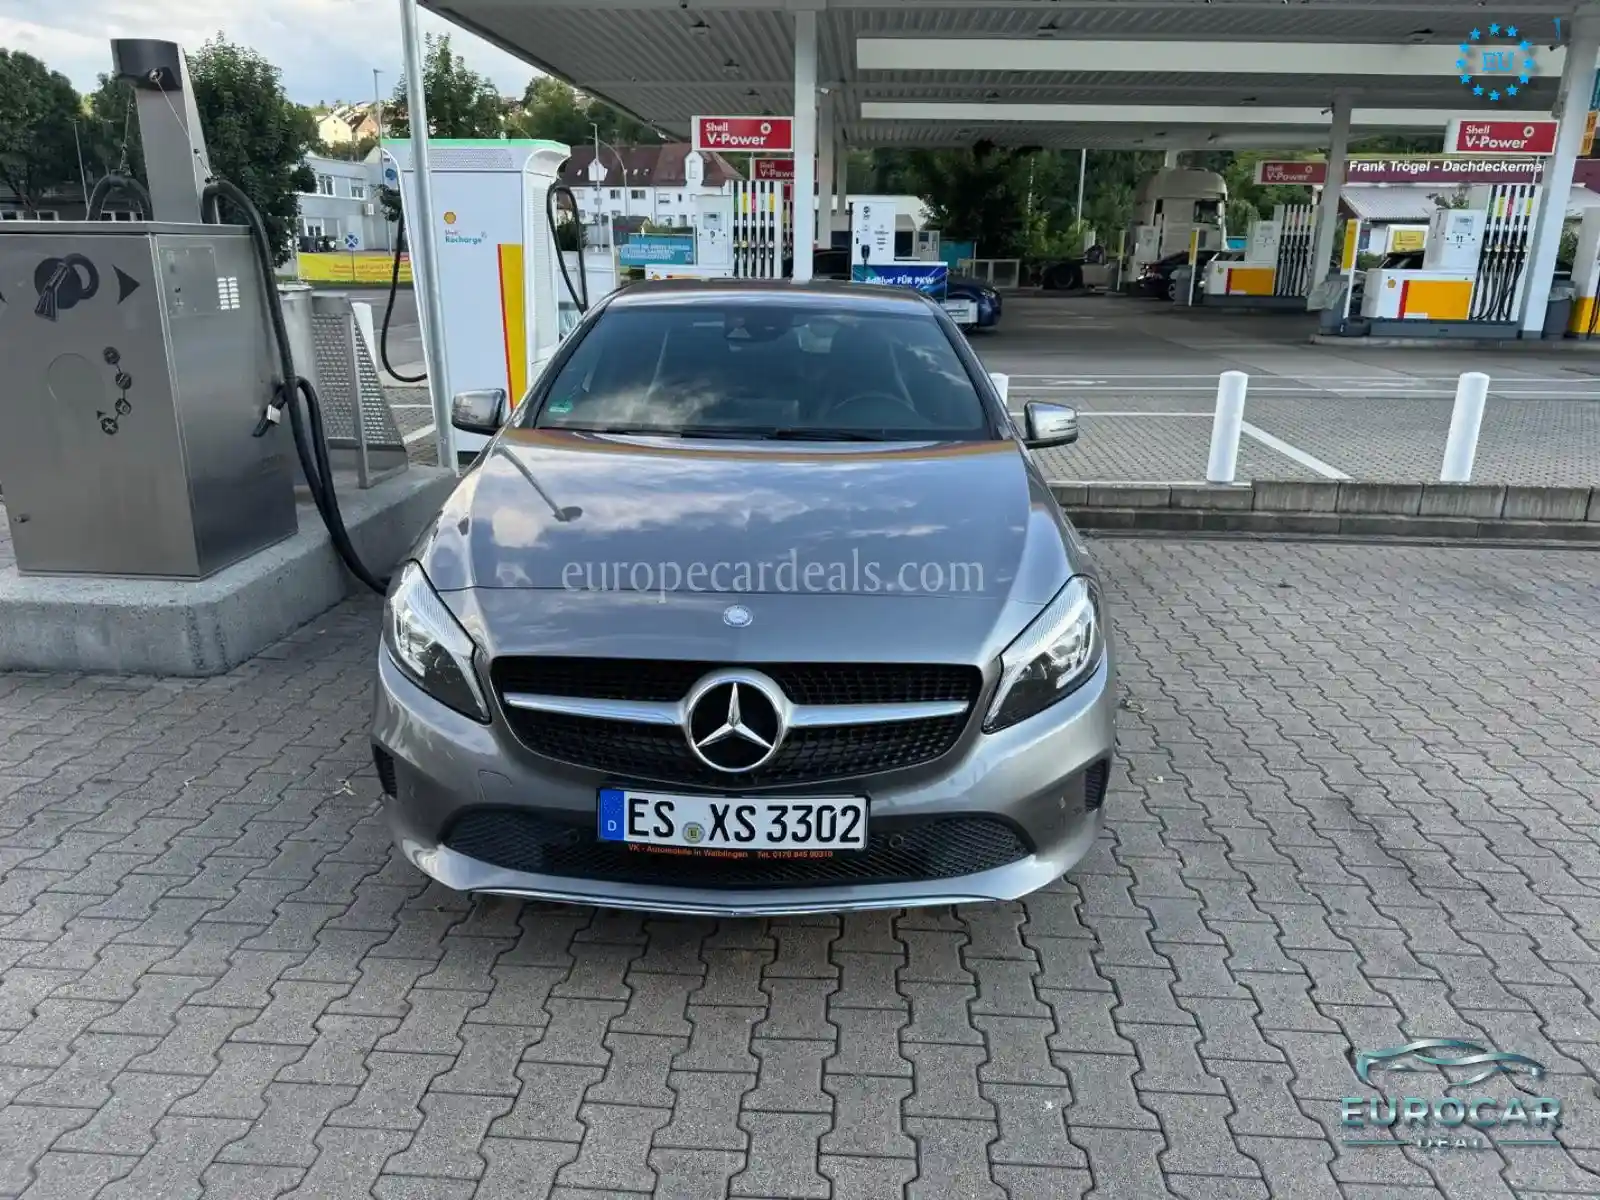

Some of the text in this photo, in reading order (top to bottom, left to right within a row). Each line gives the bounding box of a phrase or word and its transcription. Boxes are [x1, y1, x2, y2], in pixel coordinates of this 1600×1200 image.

[705, 121, 729, 132] Shell
[1466, 125, 1491, 134] Shell
[706, 133, 767, 145] V-Power
[1465, 136, 1528, 149] V-Power
[1349, 160, 1386, 172] Frank
[1391, 159, 1431, 174] Trögel
[1266, 172, 1309, 181] V-Power
[445, 236, 482, 245] Recharge
[897, 274, 913, 285] FÜR
[914, 276, 935, 285] PKW
[607, 798, 861, 843] D ES XS 3302
